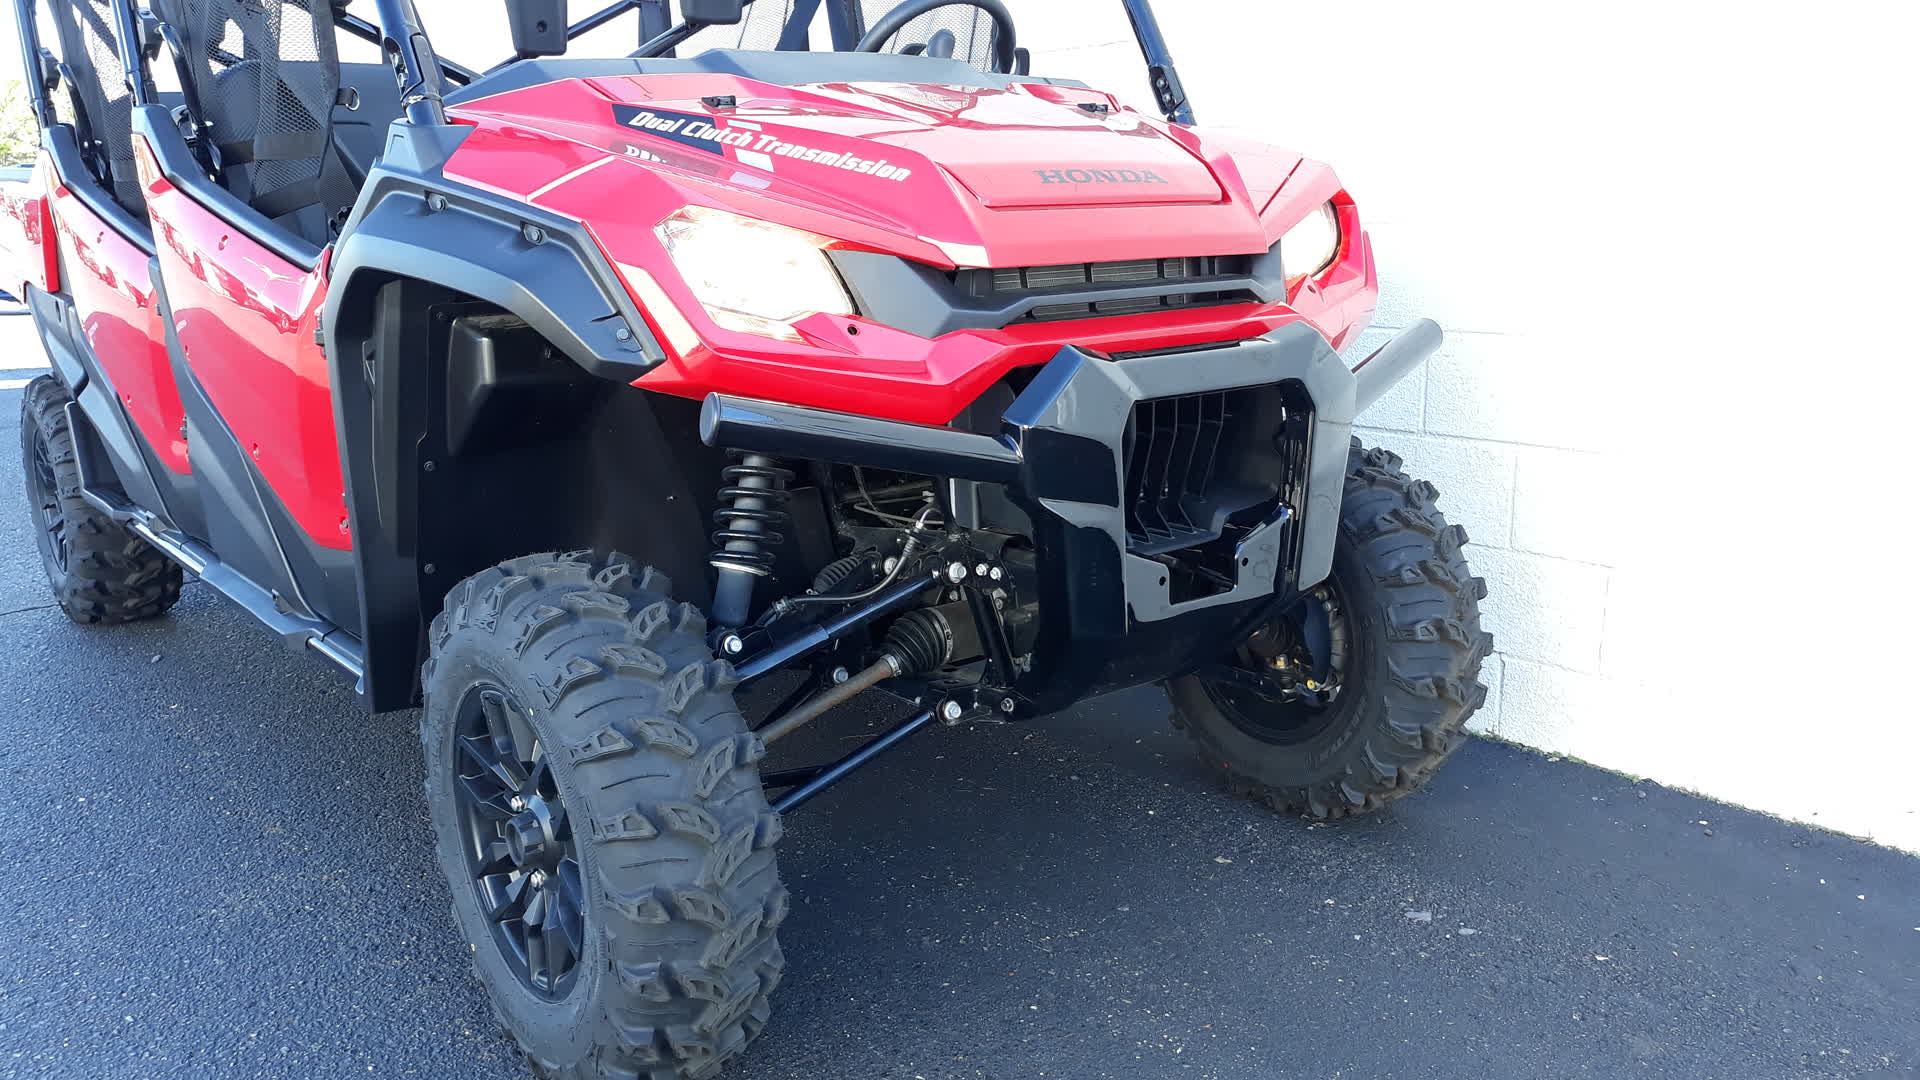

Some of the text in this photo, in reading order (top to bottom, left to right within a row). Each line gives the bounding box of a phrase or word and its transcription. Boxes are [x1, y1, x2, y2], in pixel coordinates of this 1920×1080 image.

[628, 111, 912, 182] Dual Clutch Transmission
[1034, 168, 1169, 184] HONDA
